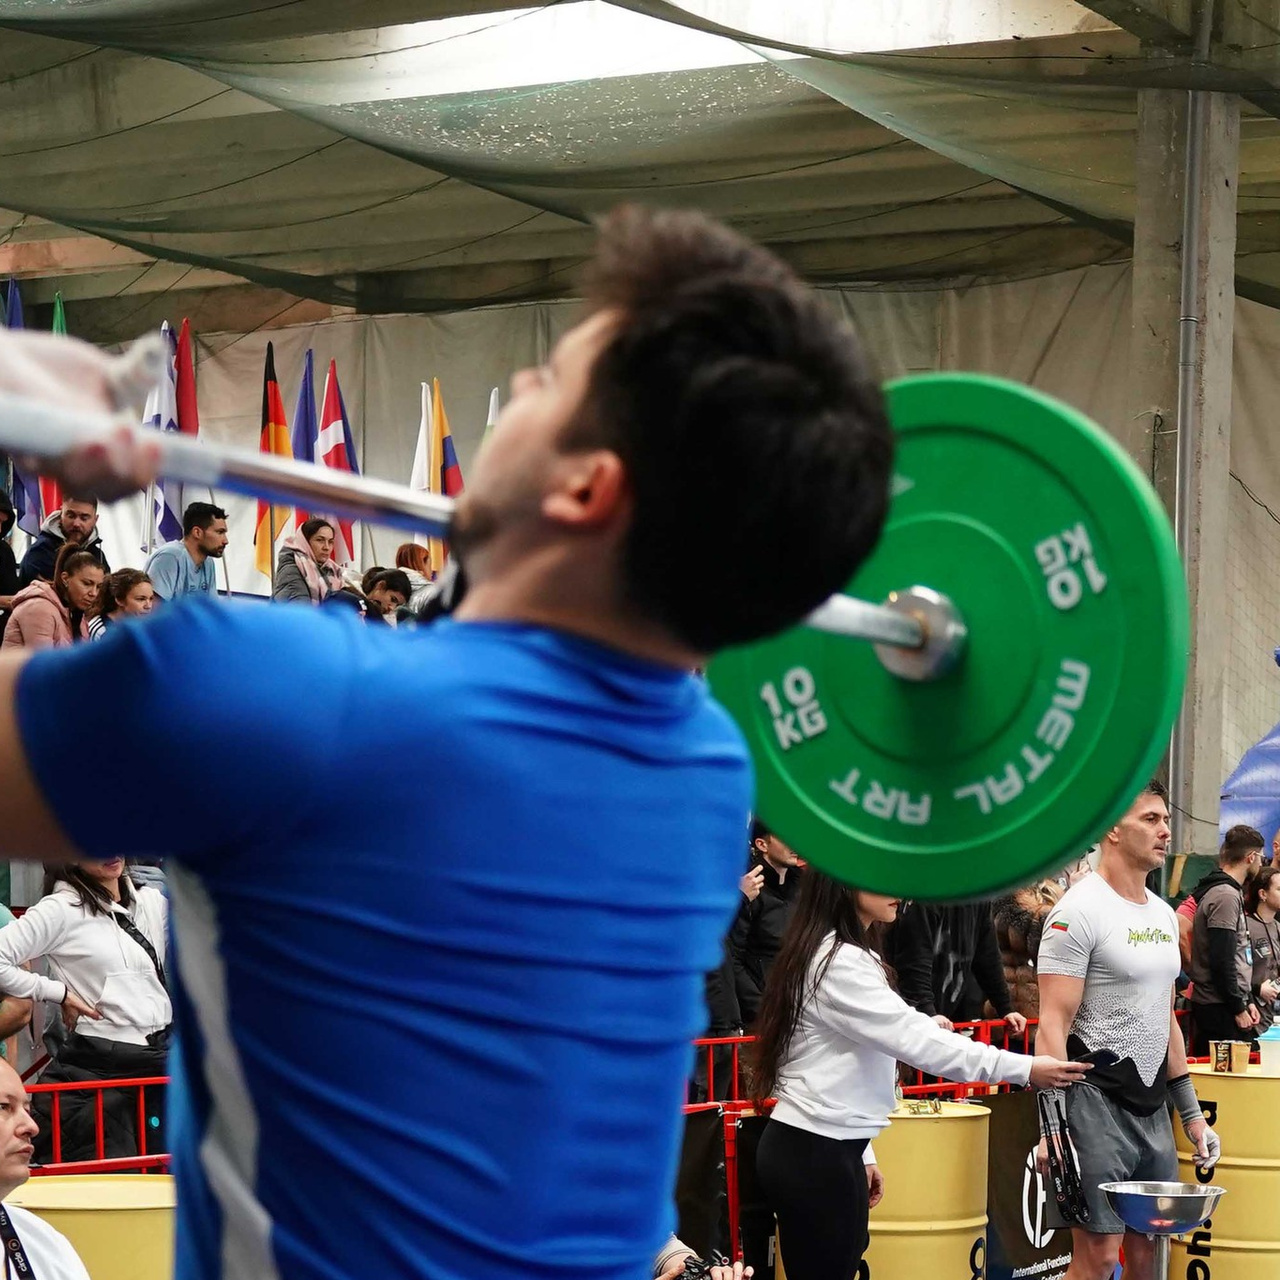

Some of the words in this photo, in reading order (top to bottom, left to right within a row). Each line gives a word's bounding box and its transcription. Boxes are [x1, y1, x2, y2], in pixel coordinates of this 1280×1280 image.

[1034, 522, 1091, 574] KG
[1046, 557, 1107, 611] 10
[761, 666, 816, 718] 10
[773, 701, 828, 751] KG
[953, 657, 1091, 815] METAL
[829, 767, 932, 826] ART
[15, 1251, 27, 1272] circle
[1011, 1259, 1048, 1279] International
[1047, 1252, 1073, 1270] Functional
